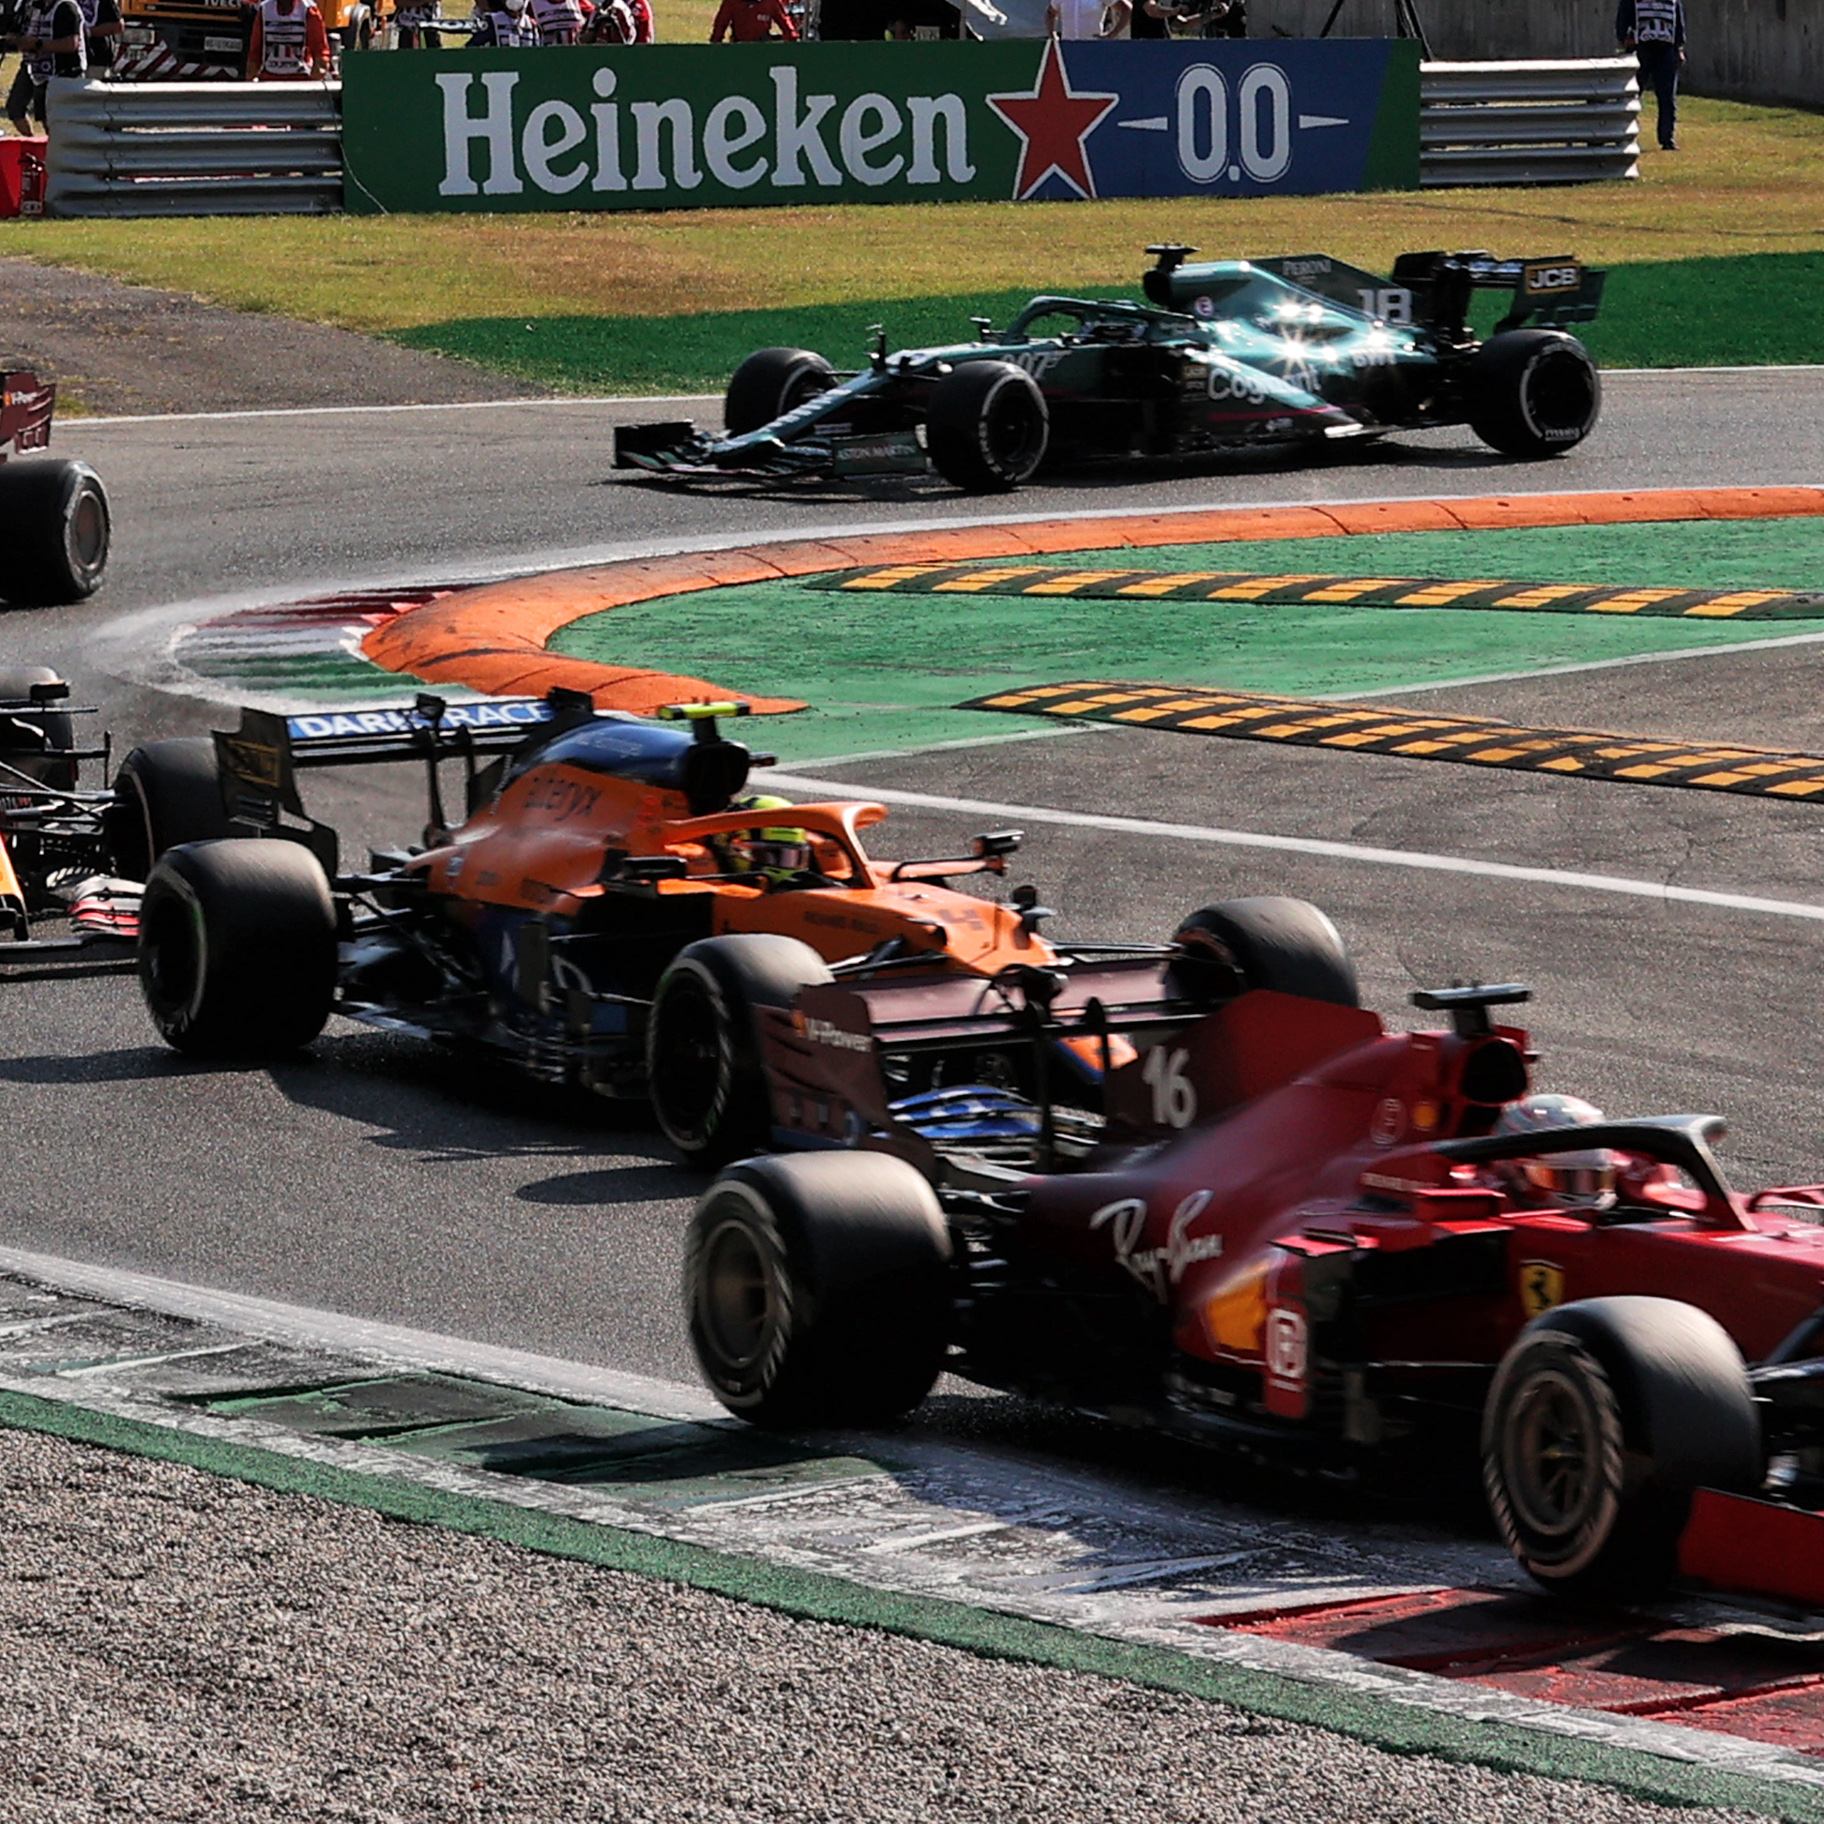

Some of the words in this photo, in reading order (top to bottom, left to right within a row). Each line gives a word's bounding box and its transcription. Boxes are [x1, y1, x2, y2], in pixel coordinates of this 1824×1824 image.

[435, 65, 976, 196] Heineken
[1176, 61, 1293, 184] 0.0
[1357, 287, 1413, 324] 18
[1529, 267, 1577, 289] JCB
[1142, 1044, 1197, 1129] 16
[1089, 1188, 1224, 1305] Ray-Ban
